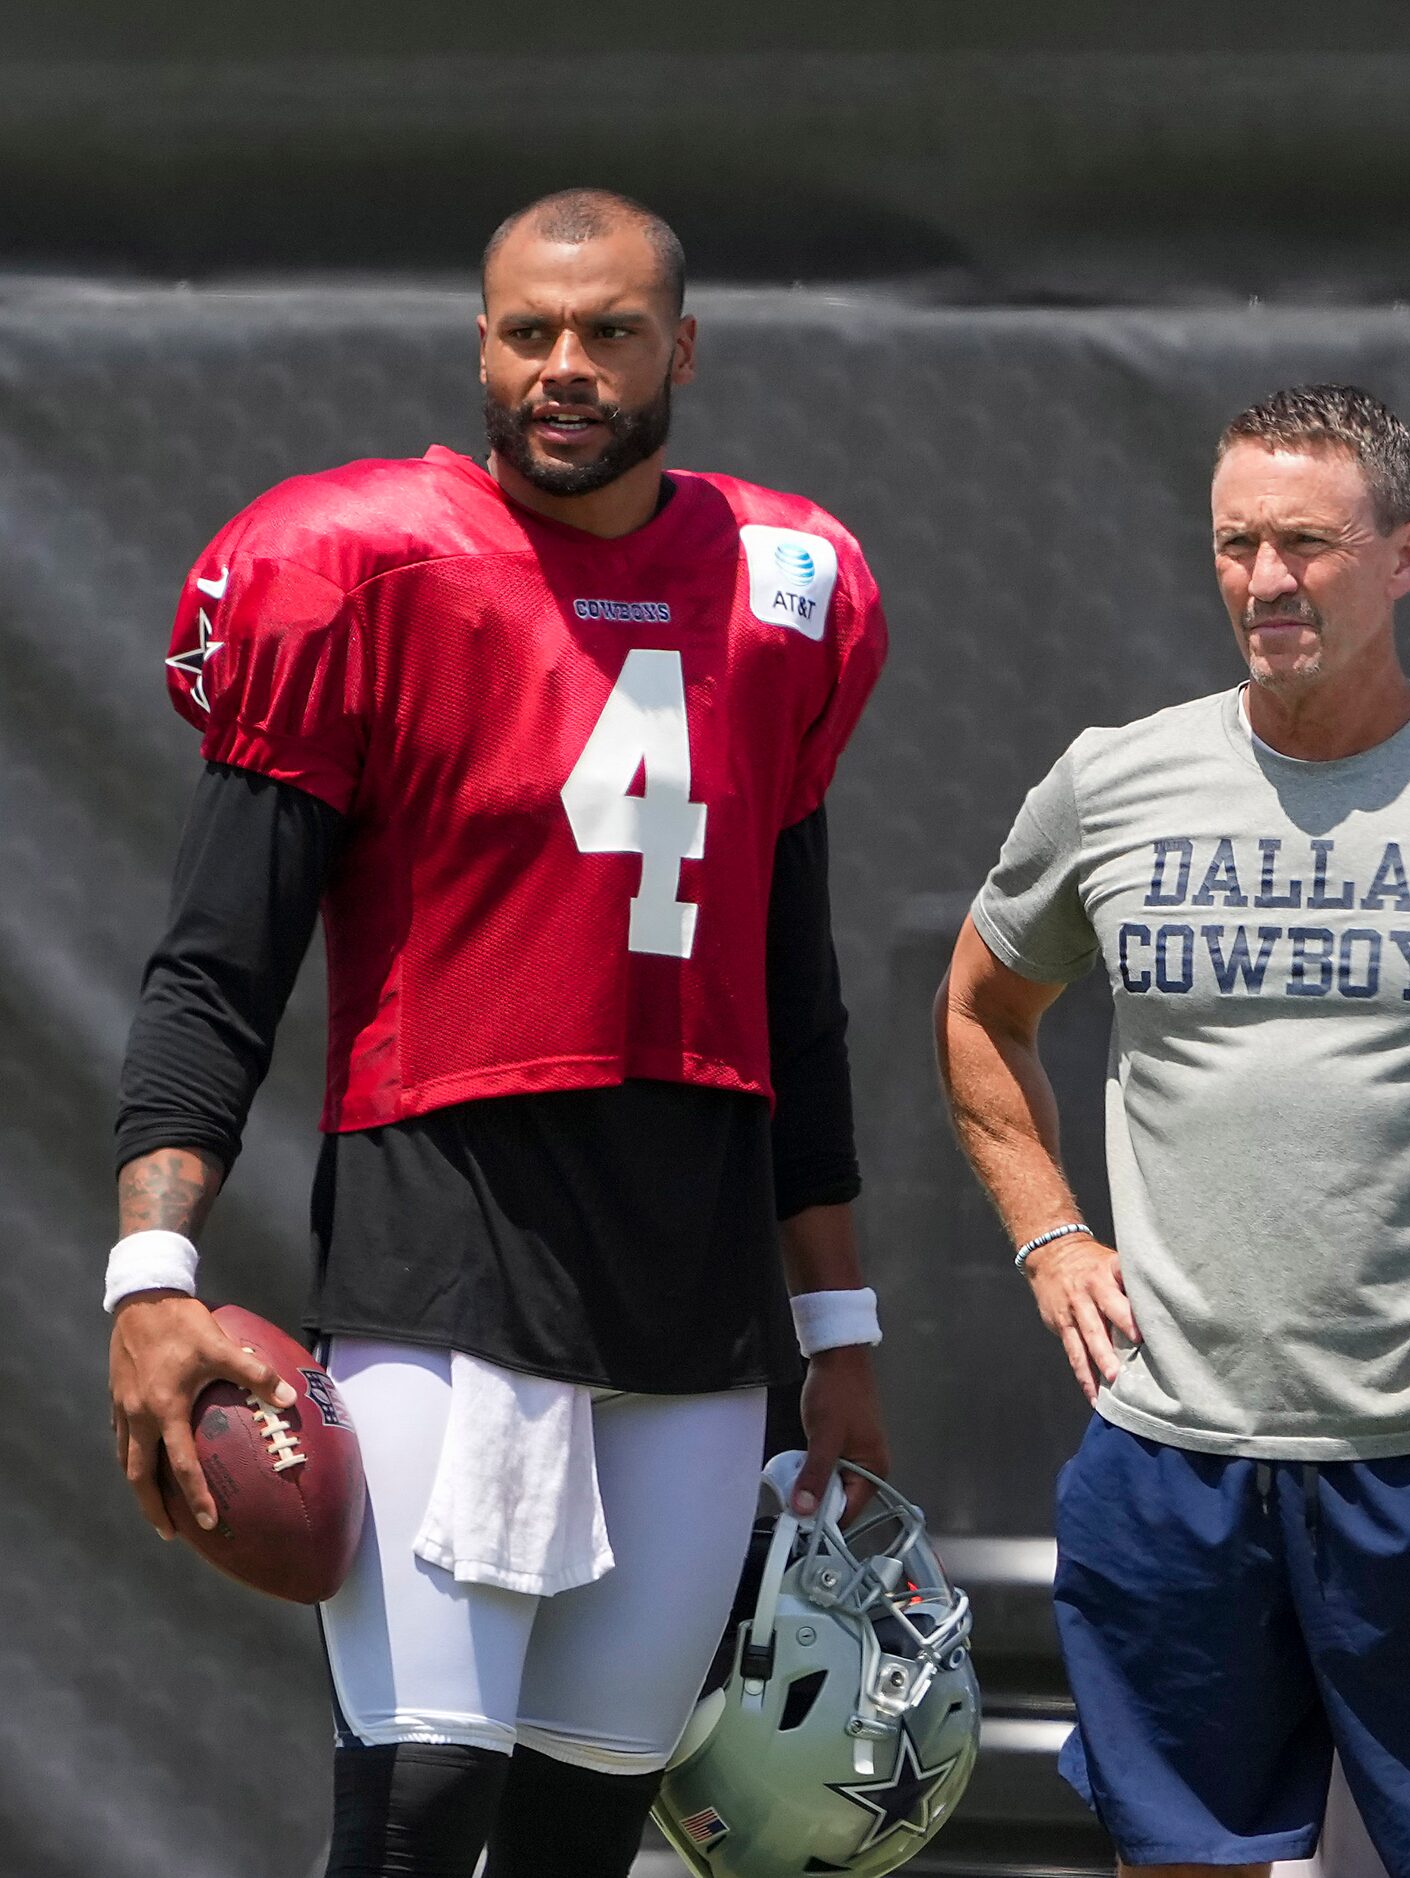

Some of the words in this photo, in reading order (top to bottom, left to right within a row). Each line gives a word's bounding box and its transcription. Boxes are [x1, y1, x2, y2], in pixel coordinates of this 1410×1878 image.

[573, 598, 671, 623] COWBOYS
[772, 590, 817, 621] AT&T
[560, 648, 708, 960] 4
